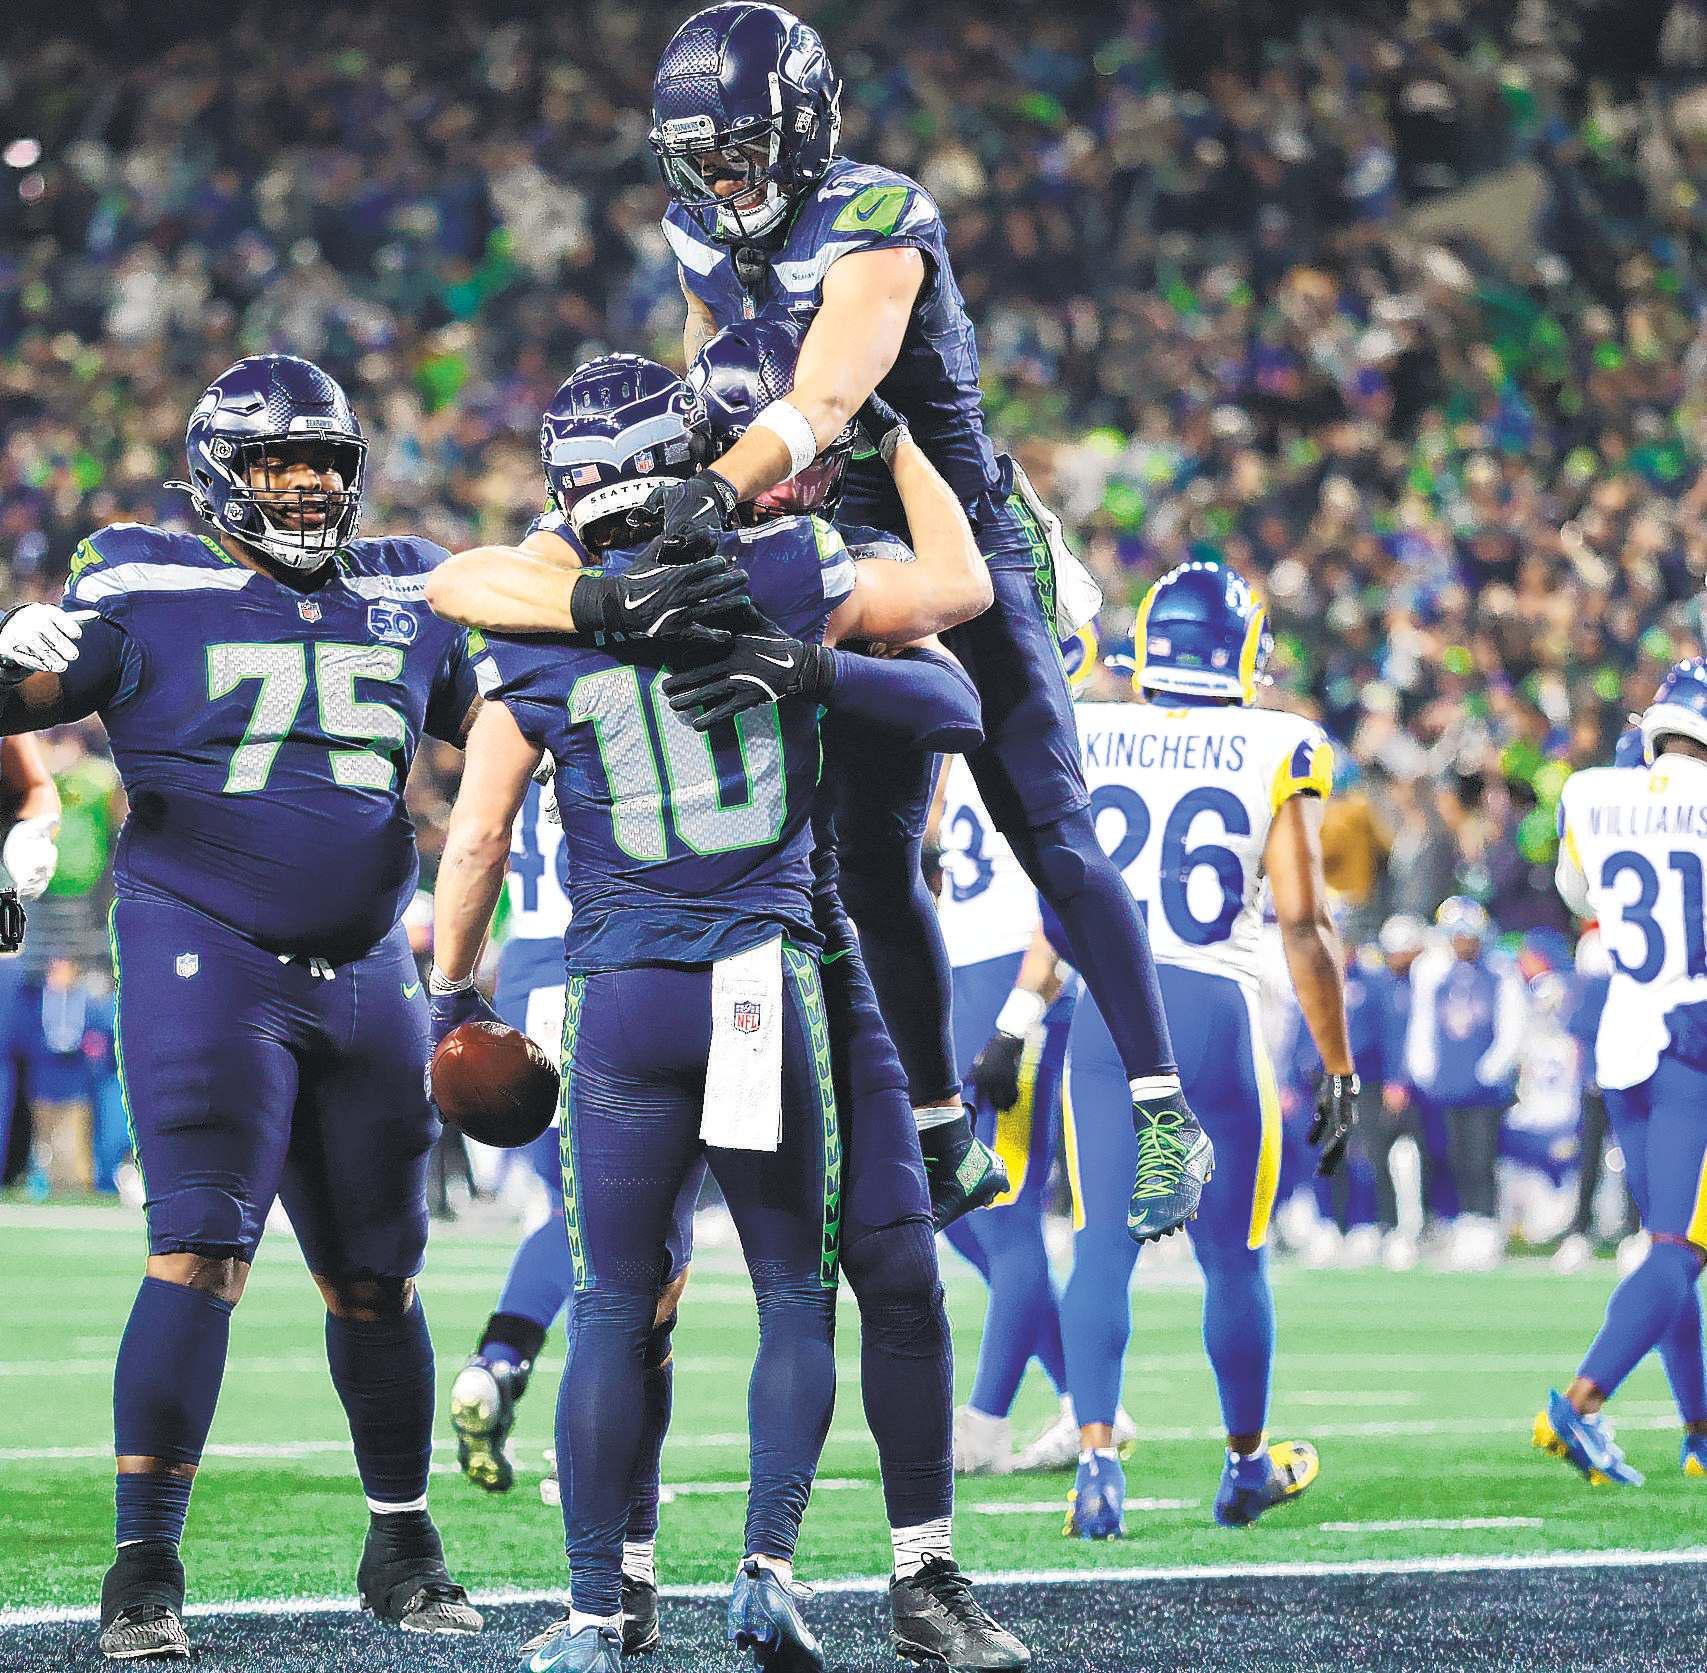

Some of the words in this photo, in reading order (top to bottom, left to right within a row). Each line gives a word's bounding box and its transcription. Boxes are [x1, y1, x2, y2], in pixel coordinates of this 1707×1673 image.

[369, 606, 418, 640] 50
[205, 641, 406, 794] 75
[566, 664, 788, 862] 10
[1085, 732, 1247, 772] KINCHENS
[1089, 784, 1251, 947] 26
[1600, 850, 1707, 985] 31
[737, 1013, 757, 1031] NFL
